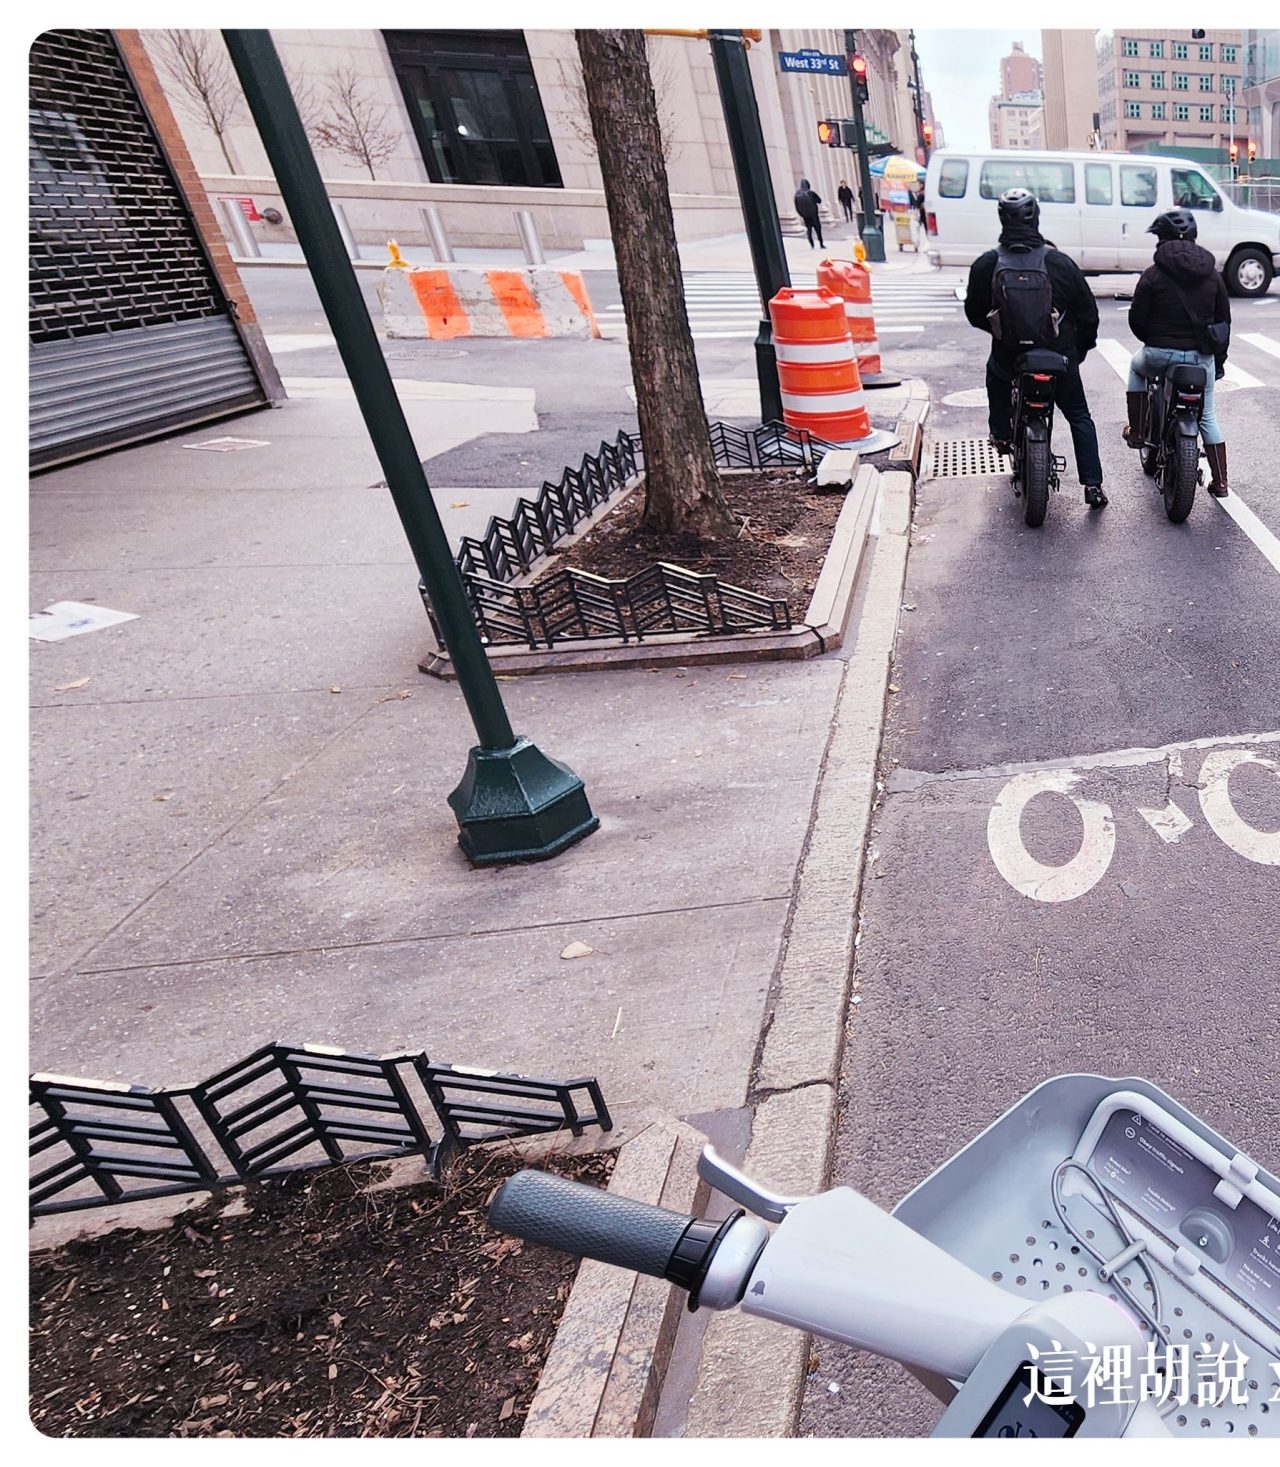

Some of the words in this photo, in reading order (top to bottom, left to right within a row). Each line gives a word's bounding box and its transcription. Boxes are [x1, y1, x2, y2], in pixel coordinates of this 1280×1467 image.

[784, 57, 809, 69] West
[811, 58, 827, 69] 33rd
[829, 60, 840, 70] St
[1138, 1136, 1153, 1150] Obey
[1151, 1147, 1168, 1161] traffic
[1166, 1158, 1185, 1174] signals
[1251, 1248, 1270, 1263] Trucks
